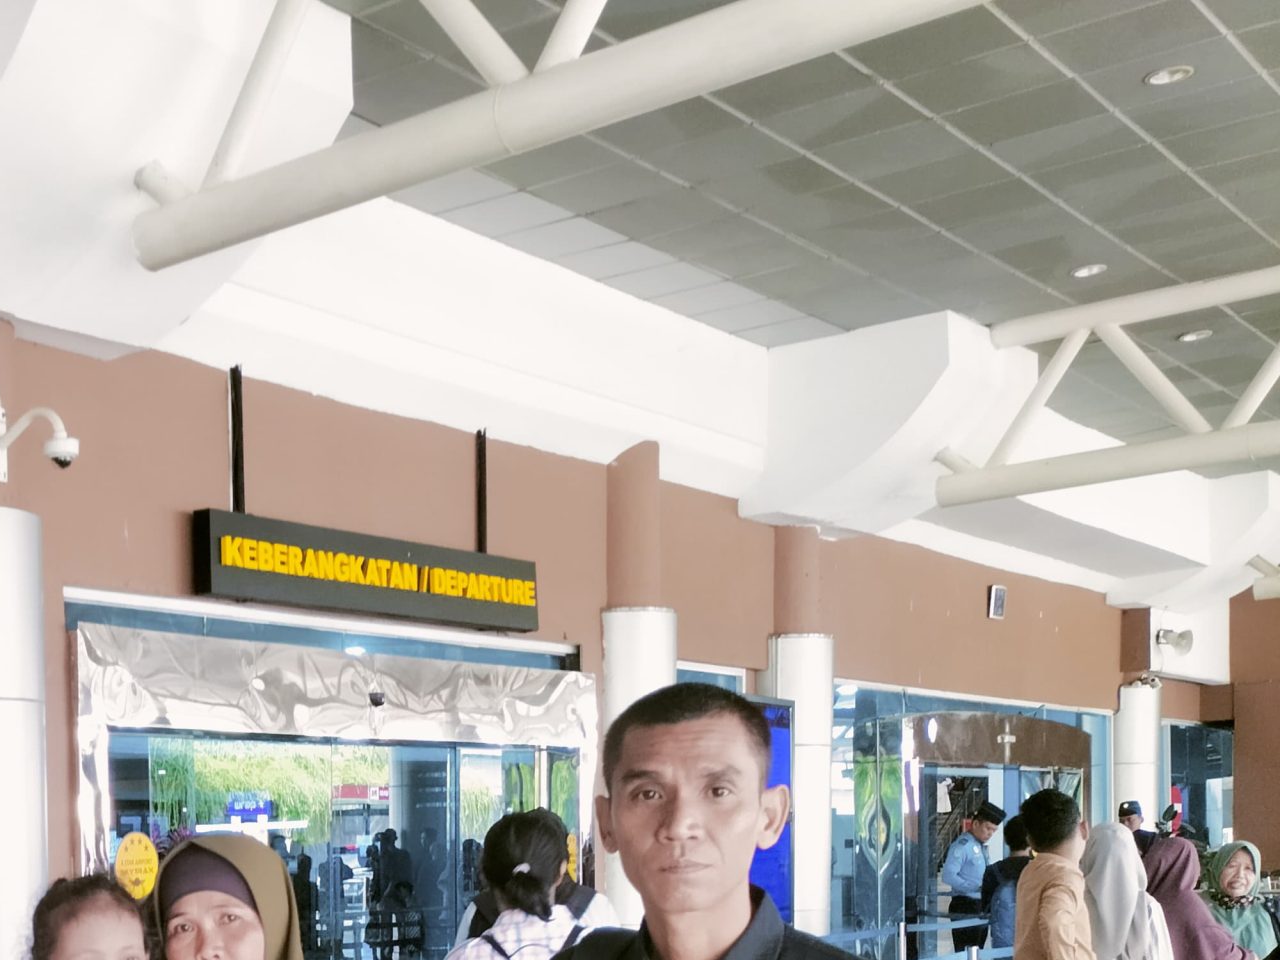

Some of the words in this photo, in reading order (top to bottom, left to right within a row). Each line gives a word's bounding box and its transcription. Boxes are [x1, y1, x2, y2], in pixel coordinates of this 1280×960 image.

[221, 535, 418, 592] KEBERANGKATAN
[421, 565, 429, 593] /
[430, 567, 536, 607] DEPARTURE
